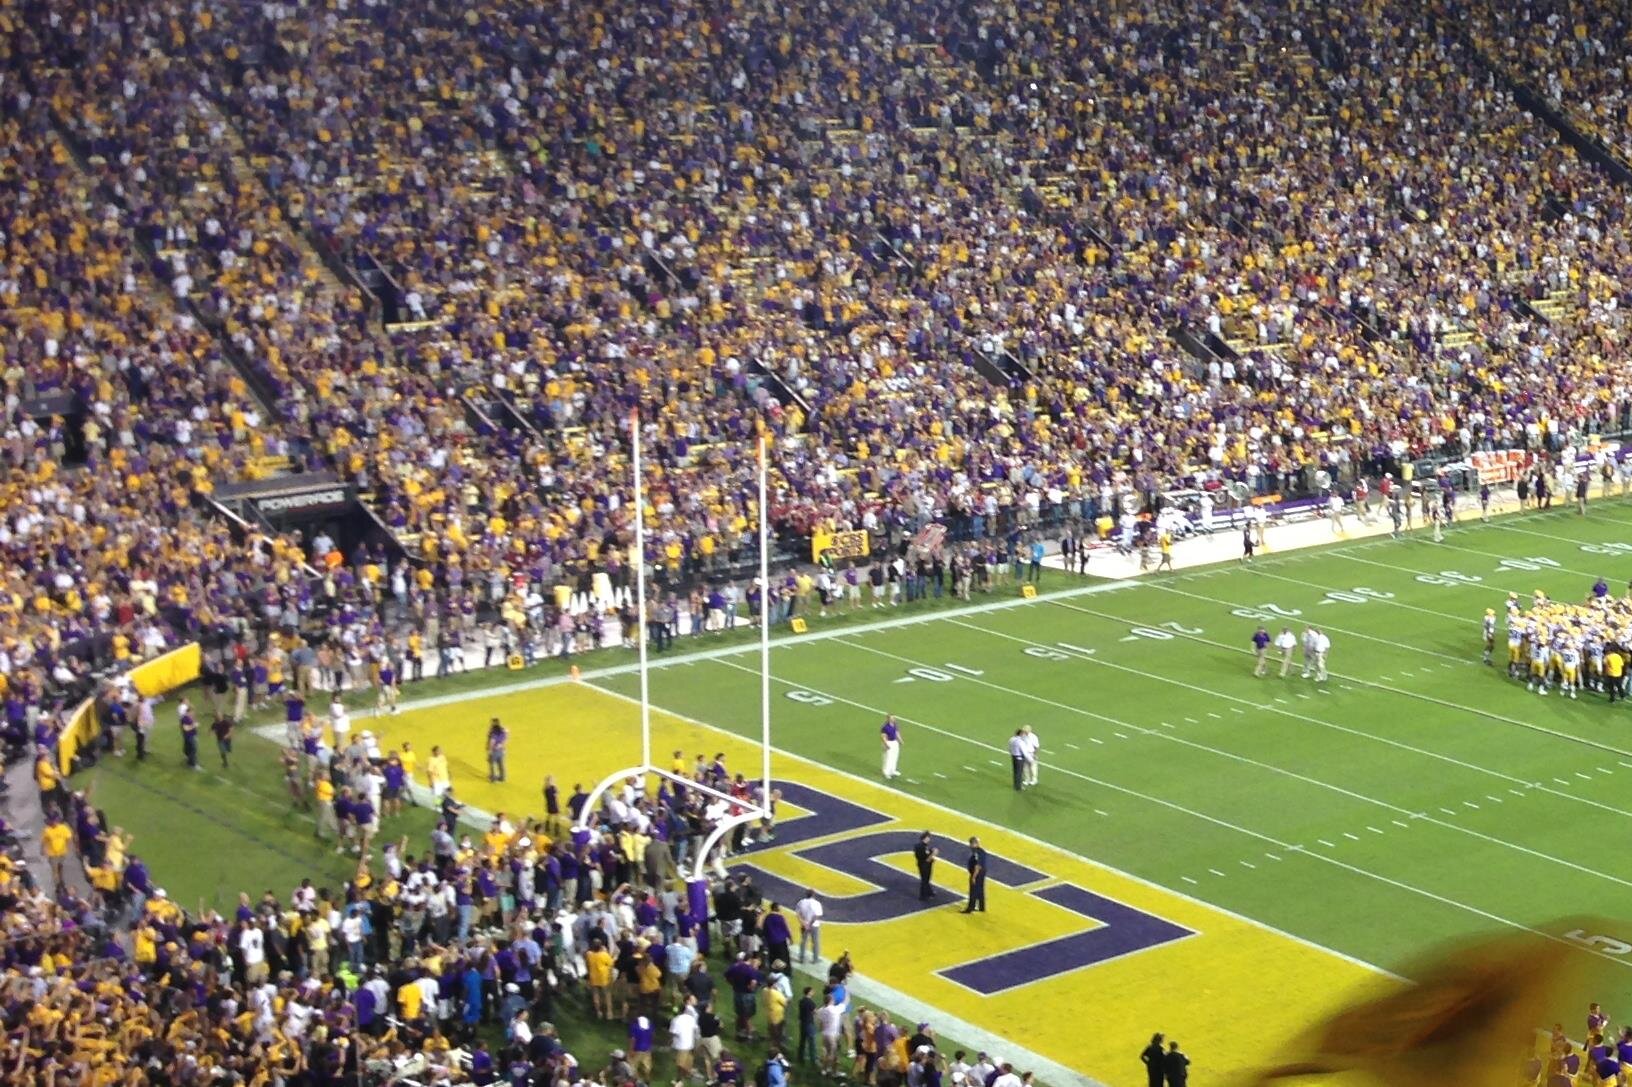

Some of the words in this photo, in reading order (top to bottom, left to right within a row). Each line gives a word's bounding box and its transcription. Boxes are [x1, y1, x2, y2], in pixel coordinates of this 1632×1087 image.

[258, 490, 345, 511] POWERADE
[1500, 556, 1561, 570] 40
[1416, 571, 1482, 586] 35
[1326, 587, 1394, 603] 30
[1232, 604, 1302, 621] 25
[1131, 621, 1203, 639] 20
[1024, 642, 1096, 660] 15
[908, 663, 984, 681] 10
[785, 691, 833, 706] 5
